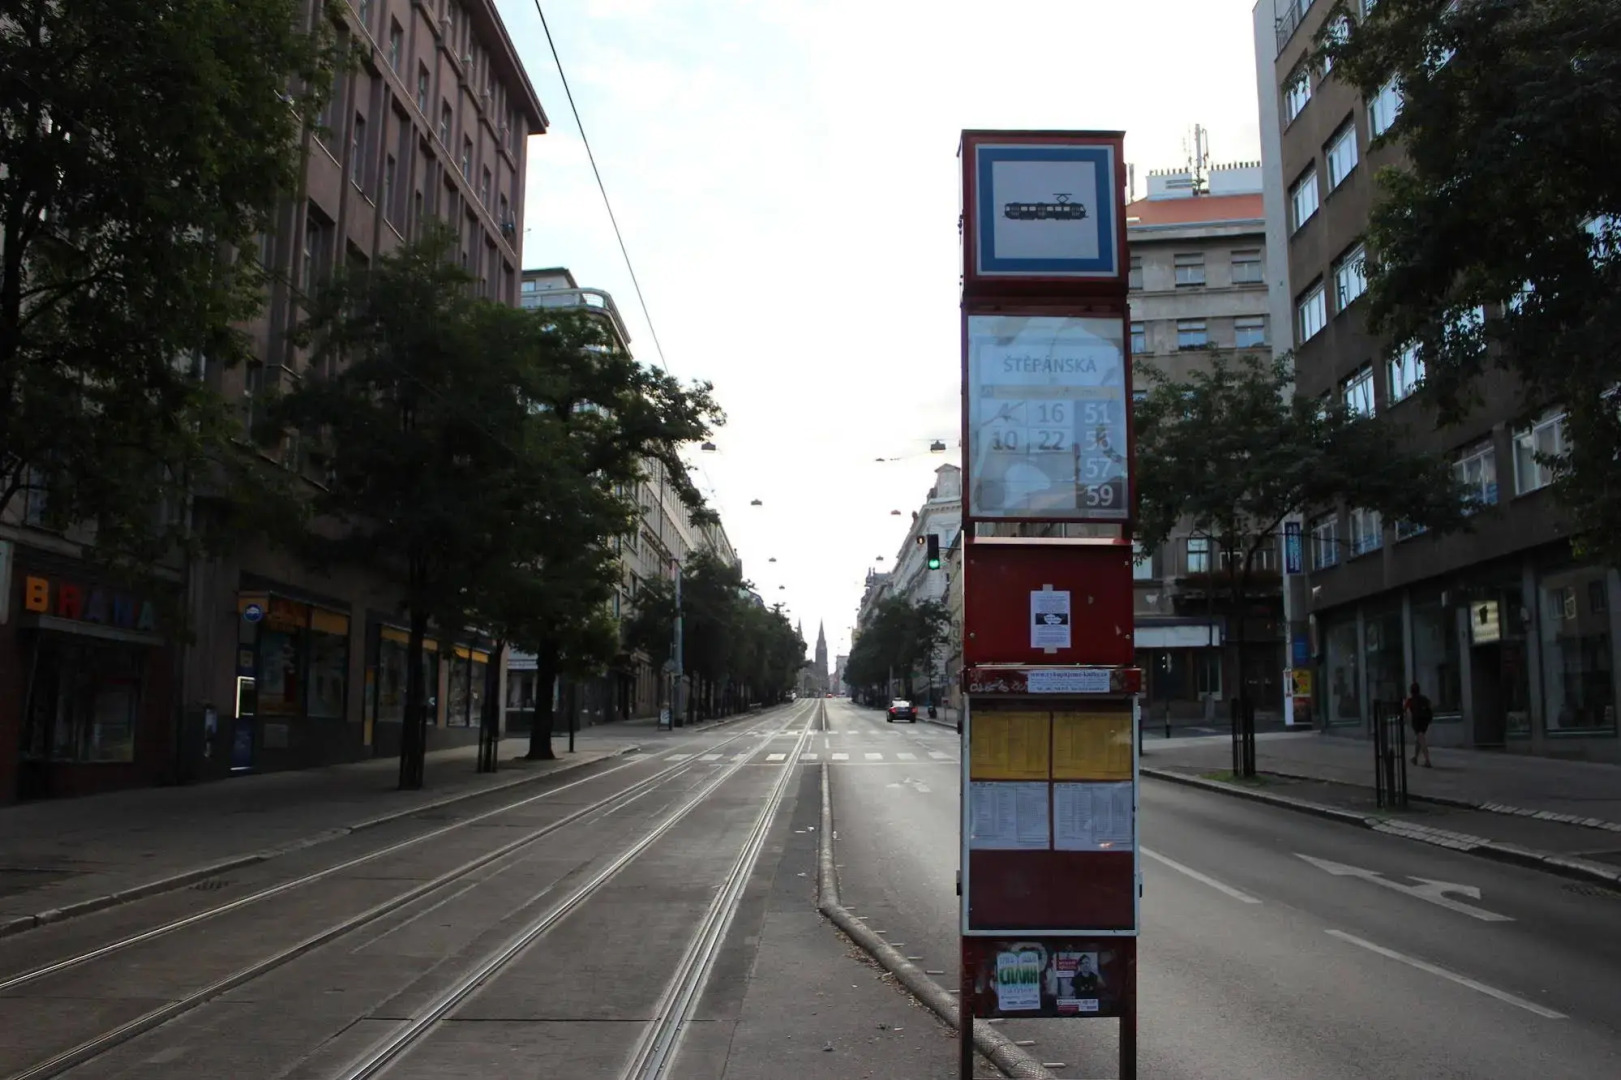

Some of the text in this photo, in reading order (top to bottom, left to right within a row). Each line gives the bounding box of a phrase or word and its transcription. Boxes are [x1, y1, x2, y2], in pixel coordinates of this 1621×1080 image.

[1003, 354, 1097, 373] ŠTĚPÁNSKÁ
[1038, 403, 1065, 423] 16
[1084, 403, 1112, 424] 51
[993, 430, 1018, 451] 10
[1038, 430, 1065, 450] 22
[1086, 458, 1112, 478] 57
[1086, 484, 1114, 507] 59
